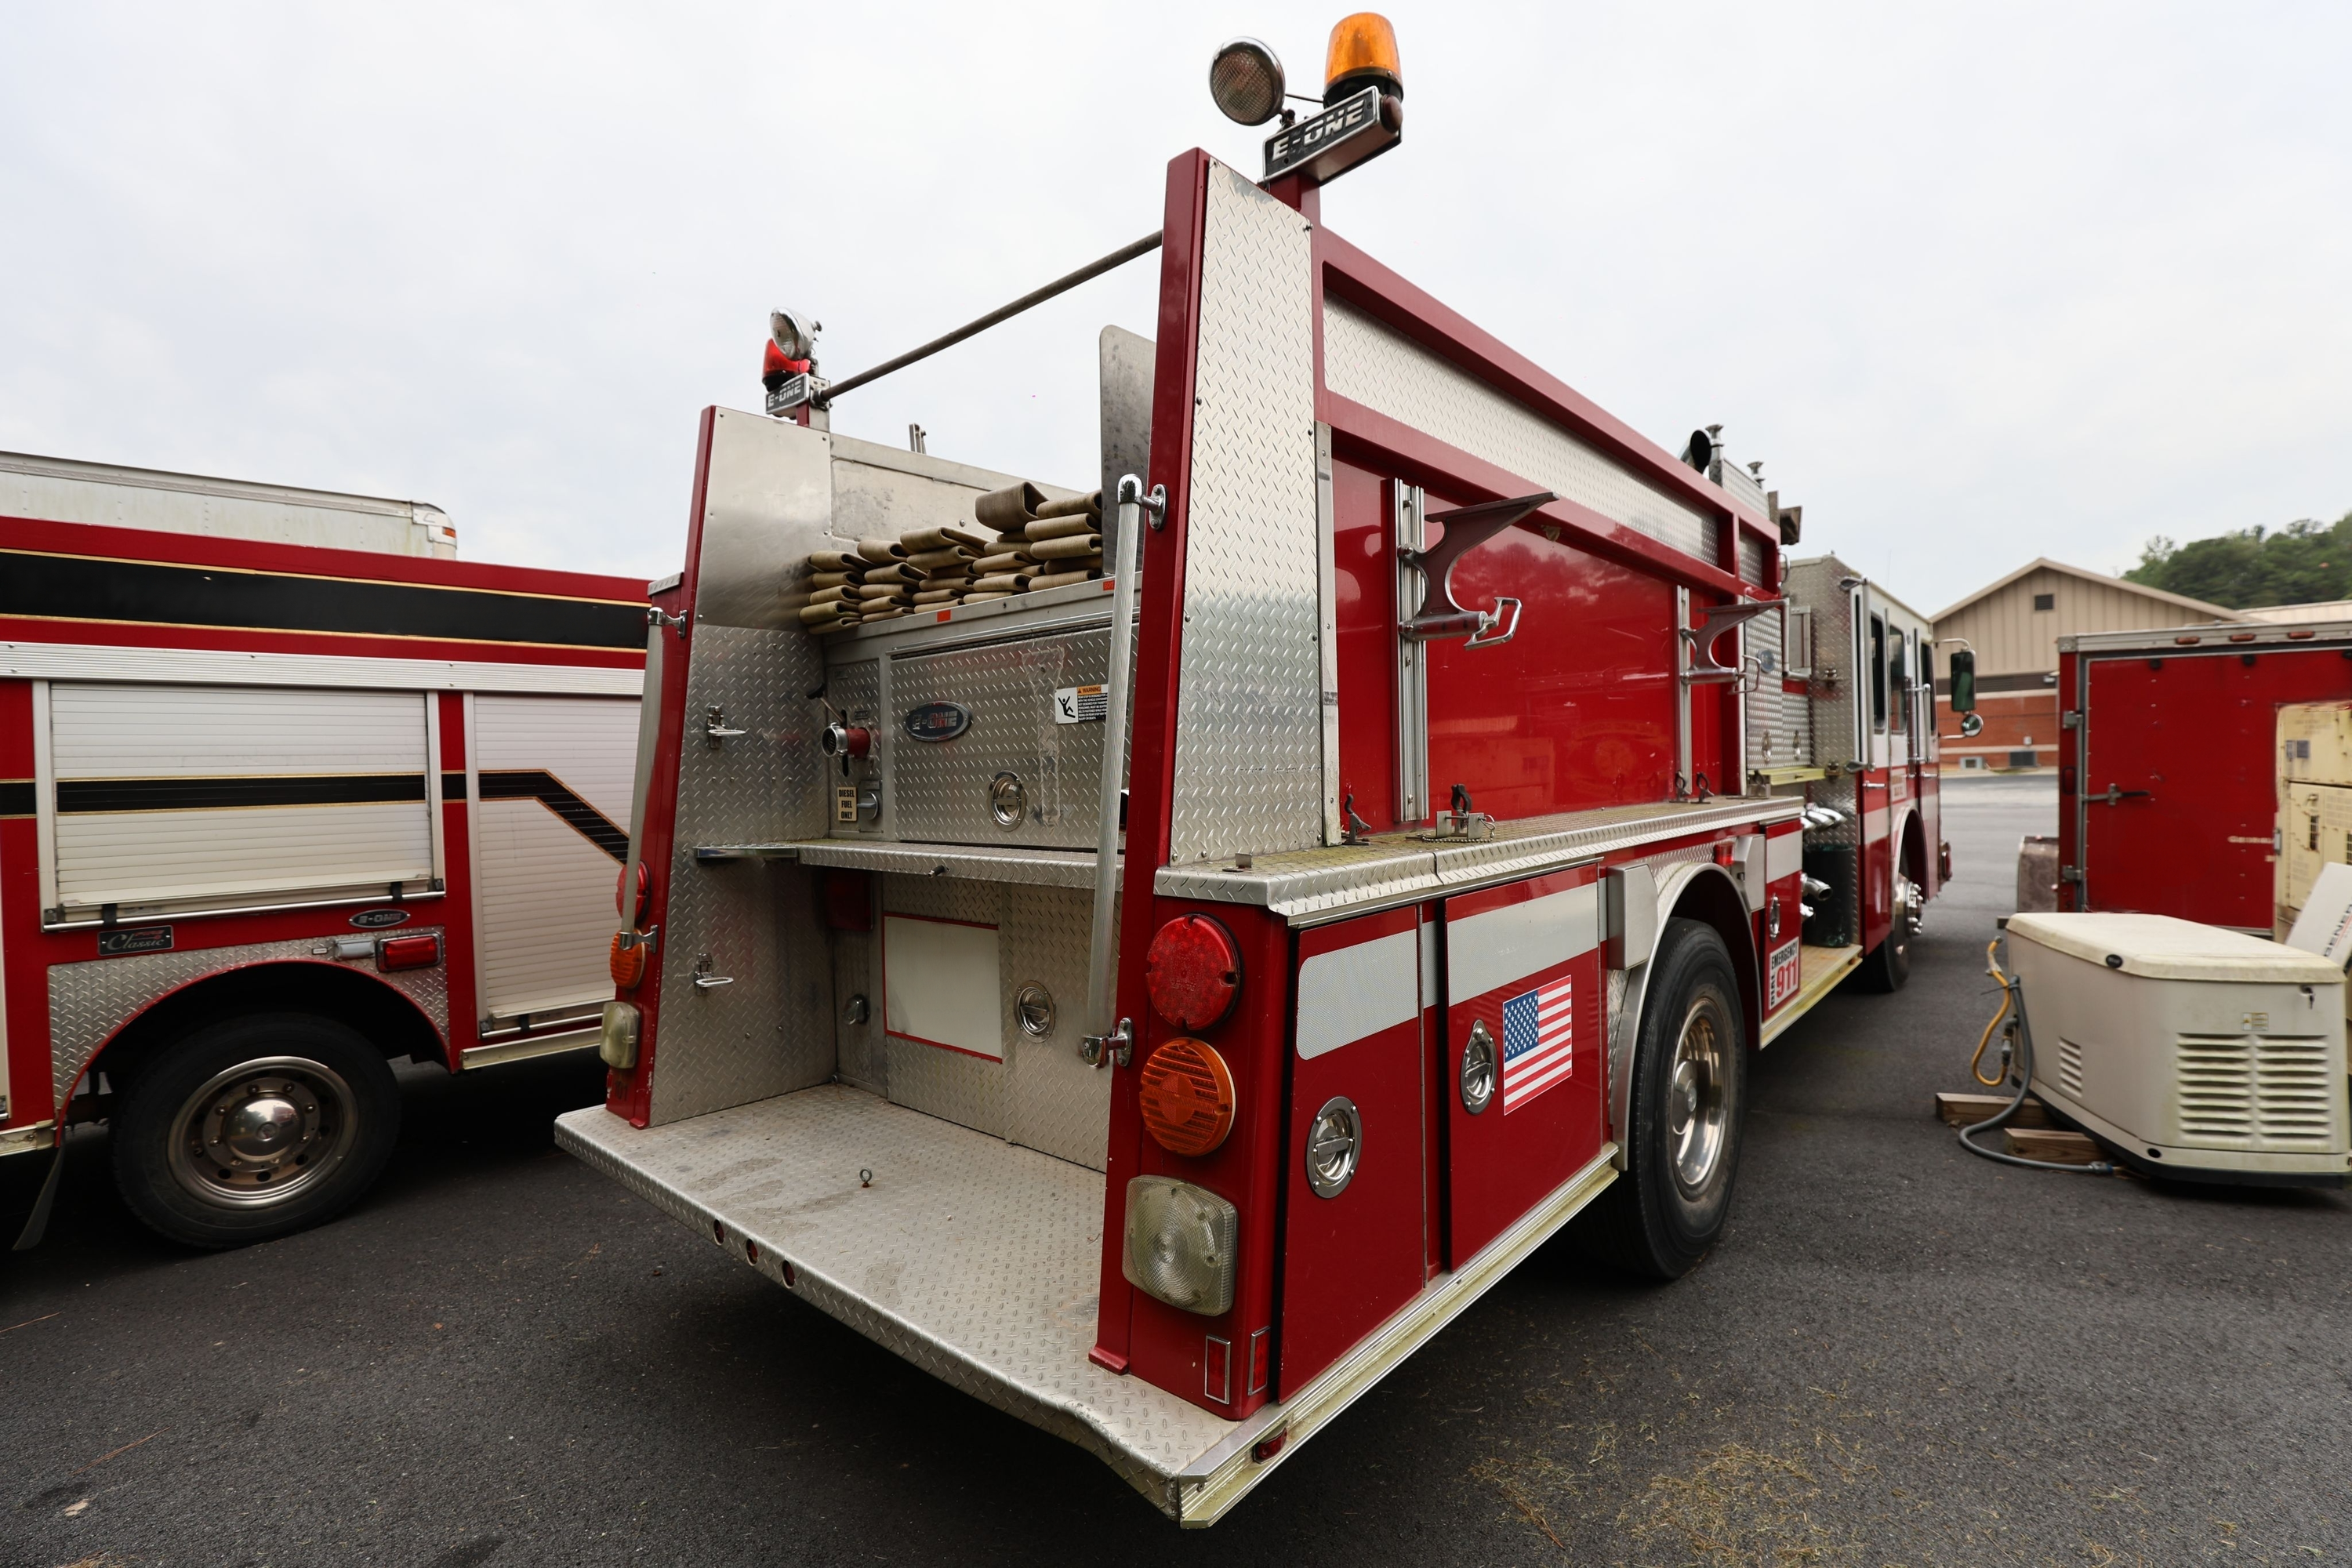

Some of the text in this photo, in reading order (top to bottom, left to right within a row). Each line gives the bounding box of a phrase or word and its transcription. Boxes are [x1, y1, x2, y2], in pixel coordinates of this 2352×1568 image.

[1272, 99, 1365, 162] E-ONE
[768, 379, 801, 408] E-ONE
[913, 710, 958, 730] E-ONE
[838, 789, 855, 797] DIESEL
[841, 800, 853, 808] FUEL
[840, 811, 853, 819] ONLY
[106, 933, 165, 950] Classic
[1771, 939, 1798, 970] EMERGENCY
[1776, 956, 1798, 999] 911
